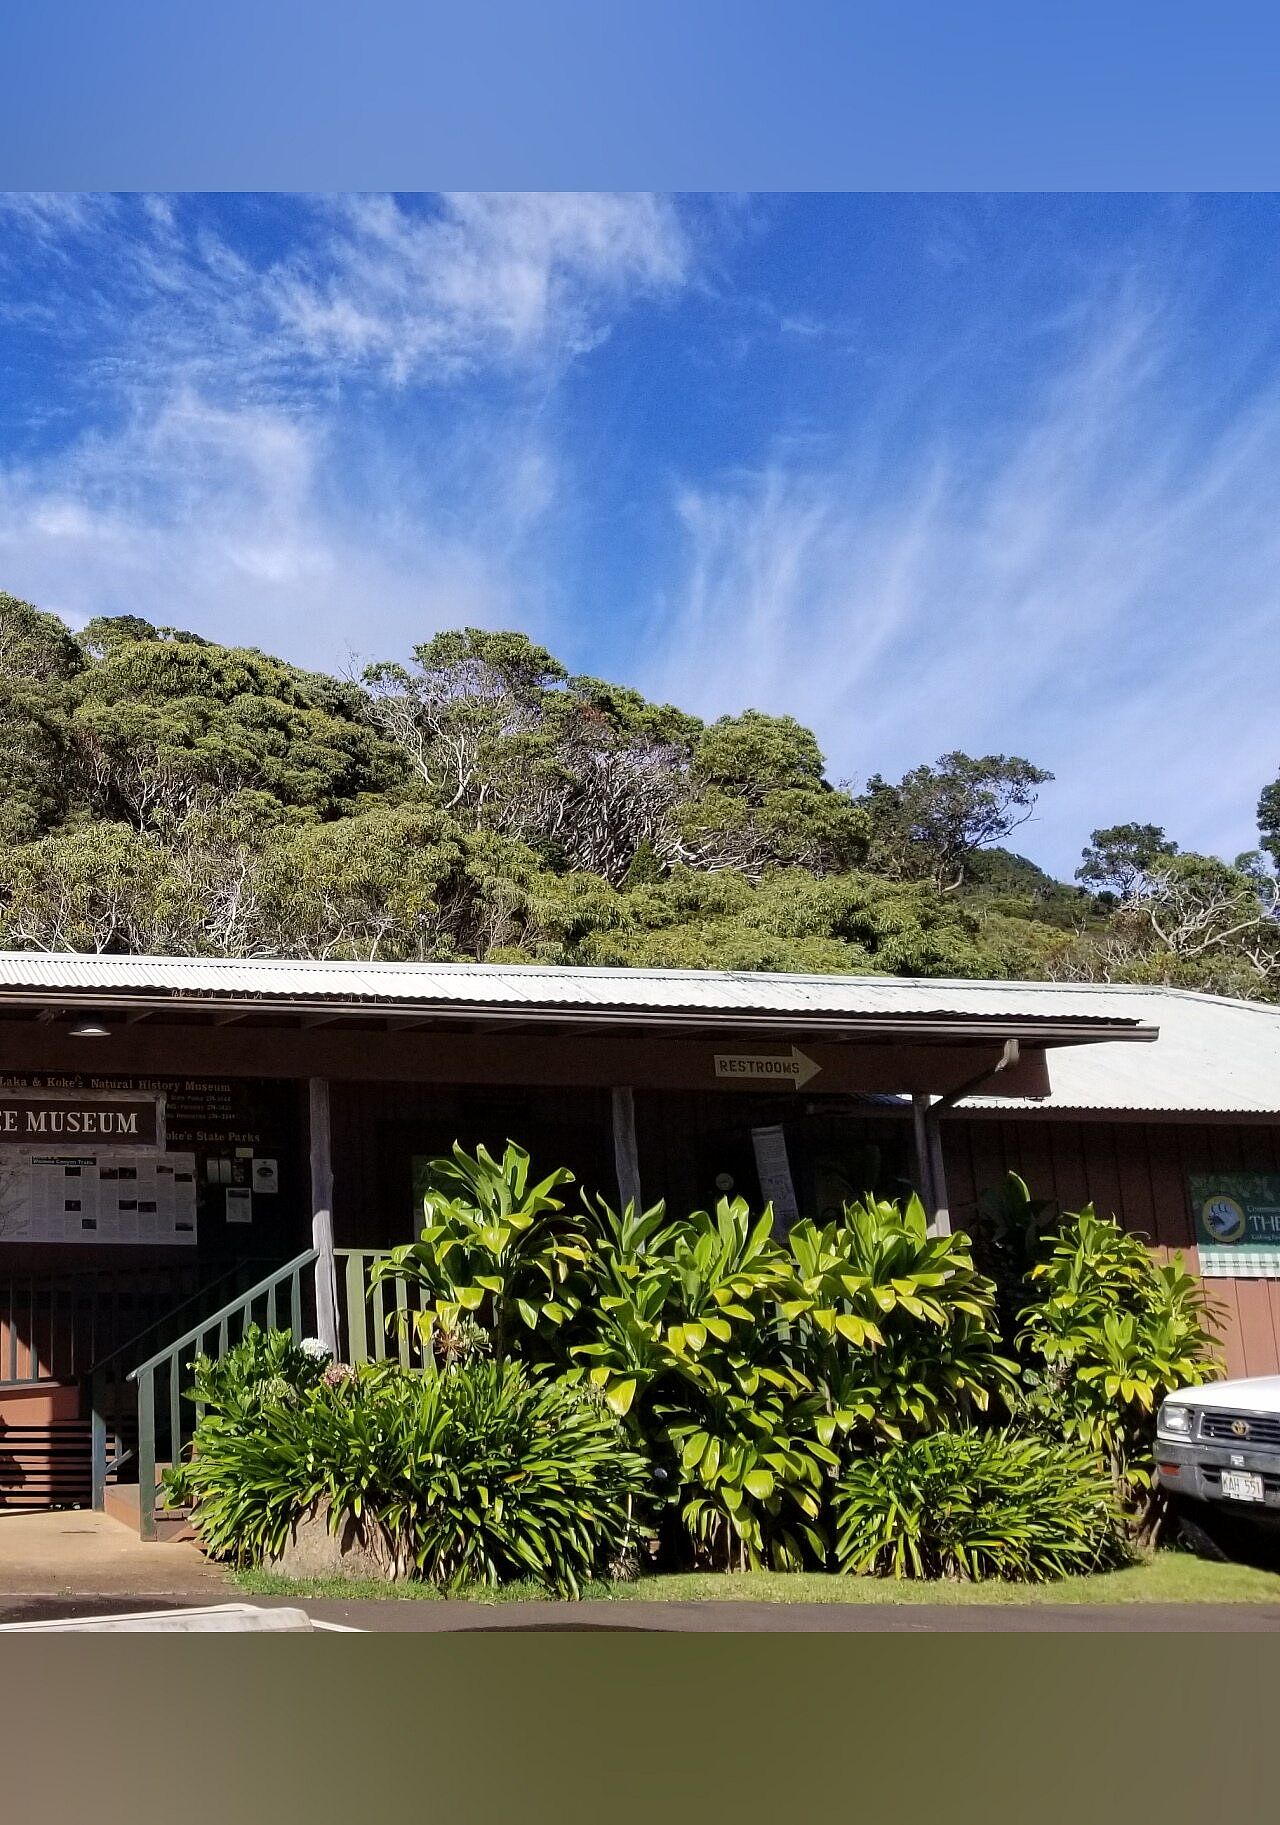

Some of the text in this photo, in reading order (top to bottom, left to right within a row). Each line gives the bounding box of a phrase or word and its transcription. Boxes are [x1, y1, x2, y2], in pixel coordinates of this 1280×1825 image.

[719, 1059, 800, 1074] RESTROOMS
[0, 1076, 28, 1087] Laka
[32, 1076, 42, 1087] &
[91, 1078, 133, 1089] Natural
[138, 1079, 180, 1092] History
[185, 1080, 232, 1092] Museum
[26, 1111, 139, 1133] MUSEUM
[166, 1131, 261, 1143] oke'e State Parks
